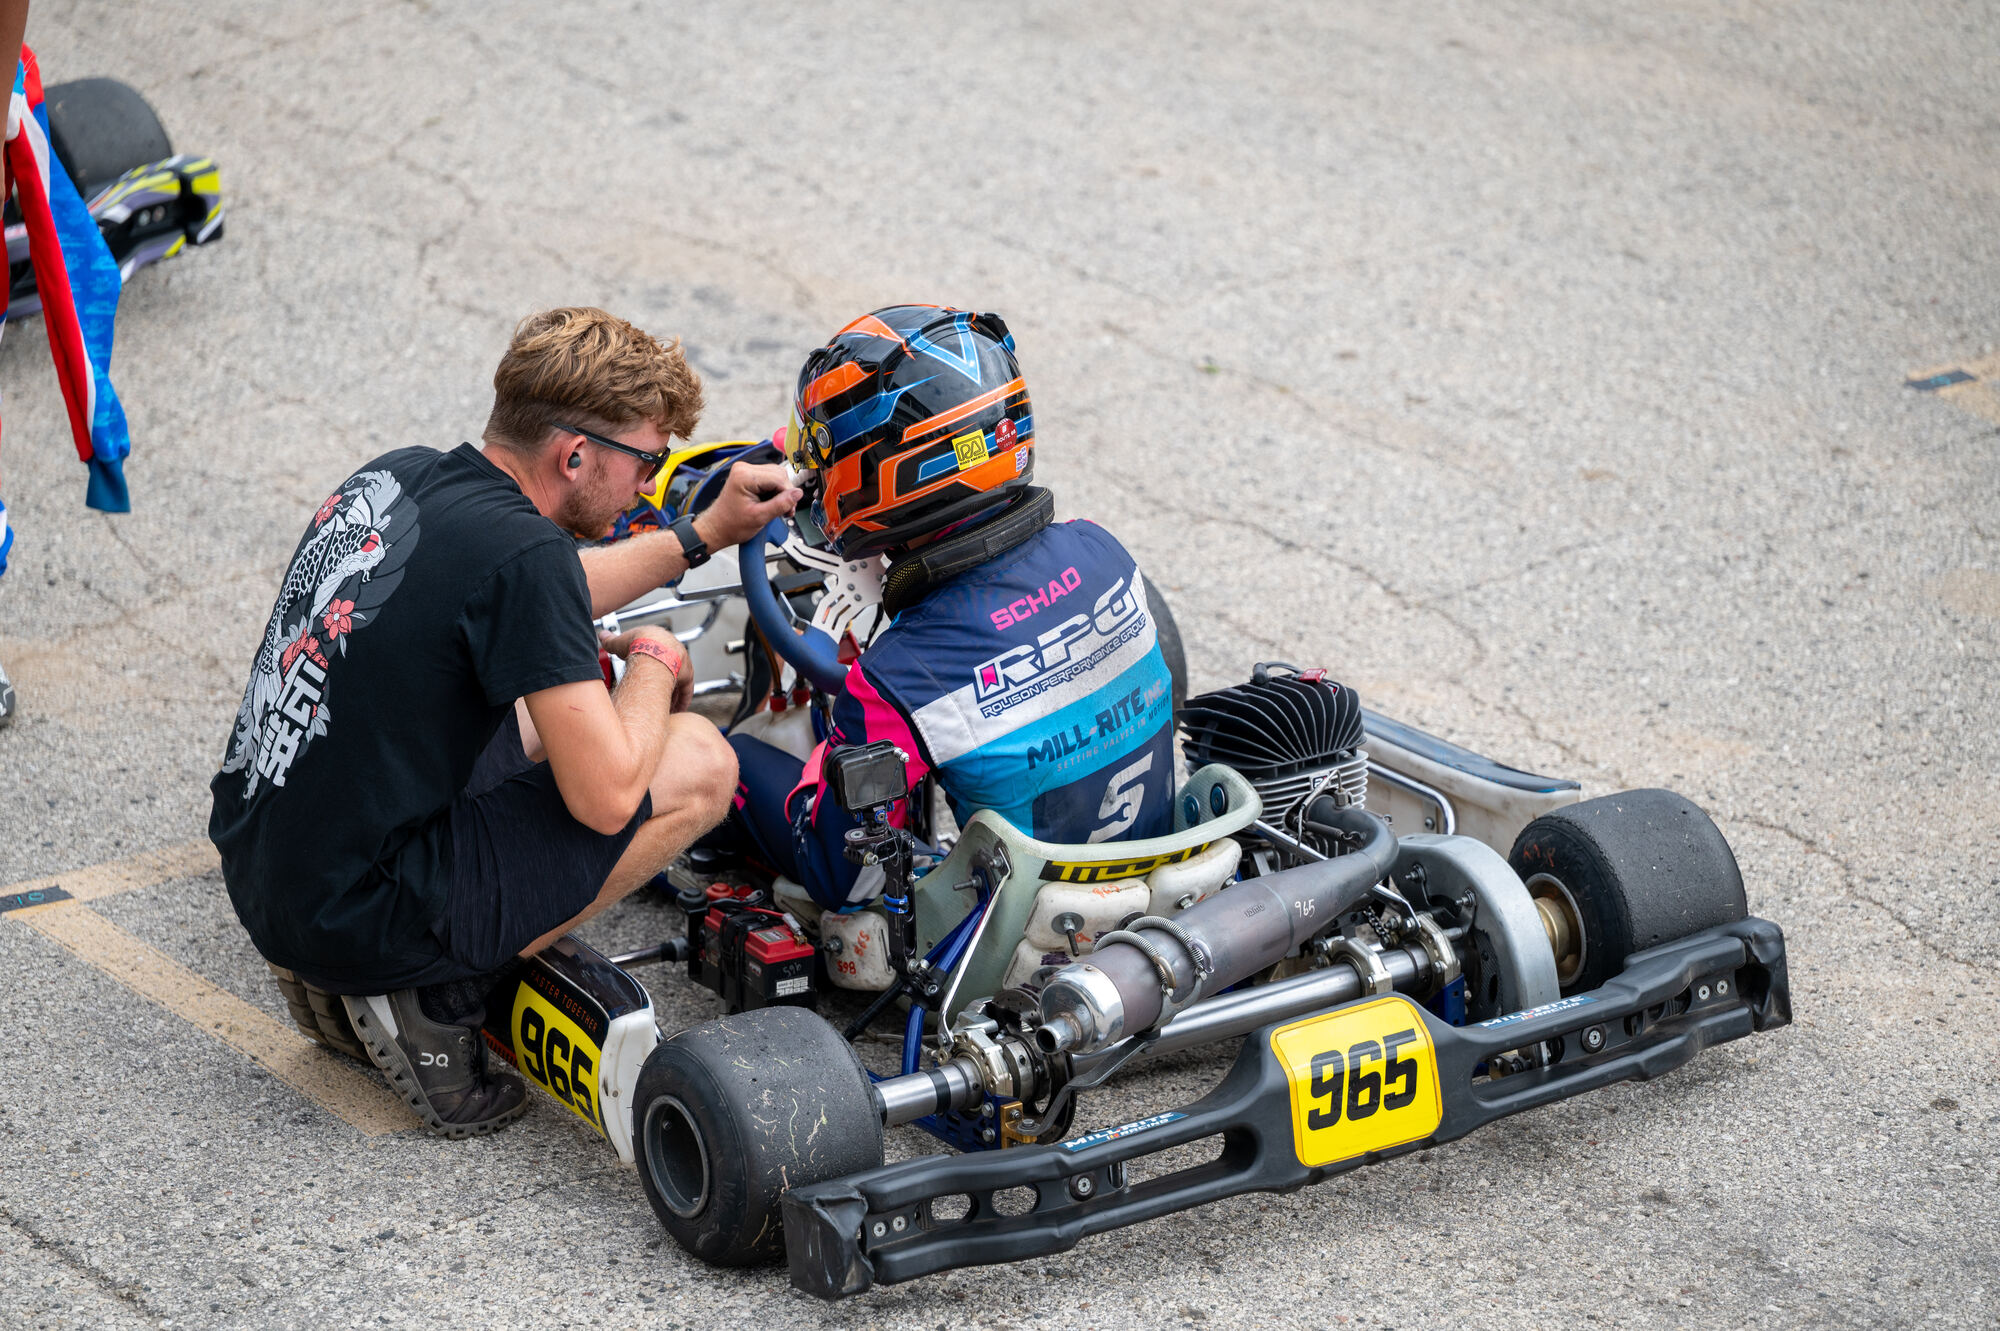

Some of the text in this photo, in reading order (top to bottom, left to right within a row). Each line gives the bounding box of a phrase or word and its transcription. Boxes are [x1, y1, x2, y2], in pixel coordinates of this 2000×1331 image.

[973, 576, 1139, 704] RPG
[989, 566, 1082, 631] SCHAD
[980, 612, 1147, 719] ROLISON PERFORMANCE GROUP
[1056, 745, 1099, 772] SETTING
[1103, 724, 1135, 750] VALVES
[1294, 898, 1316, 918] 965
[562, 993, 599, 1033] TOGETHER
[520, 1006, 599, 1127] 965
[1307, 1028, 1418, 1131] 965
